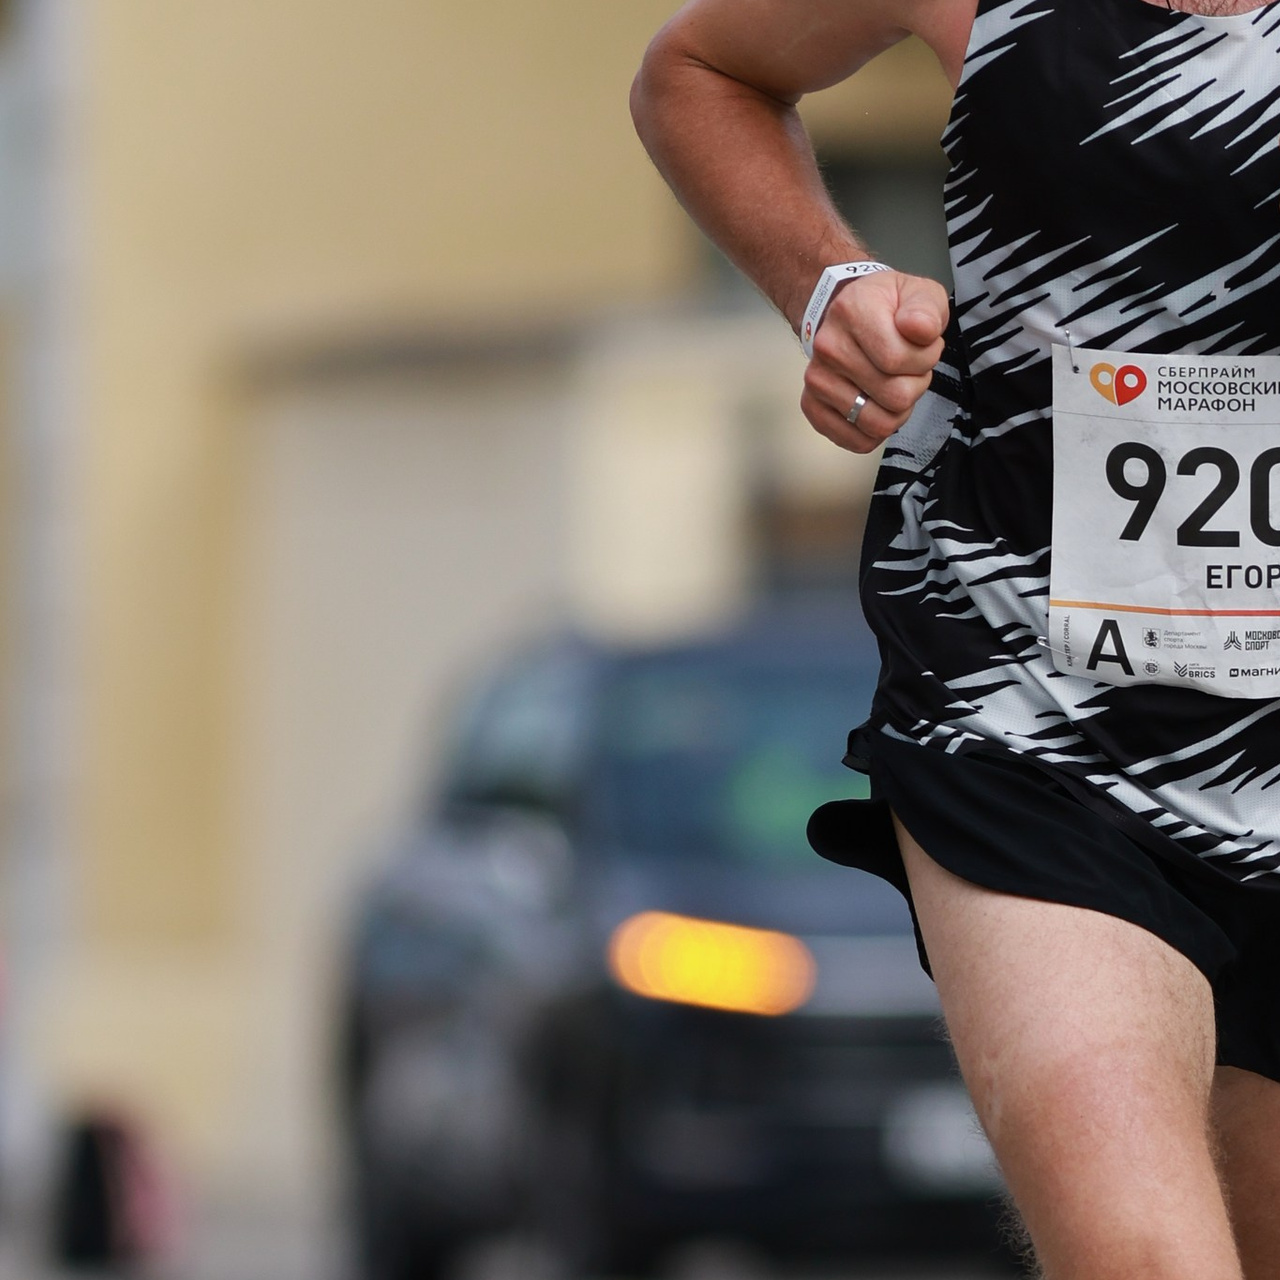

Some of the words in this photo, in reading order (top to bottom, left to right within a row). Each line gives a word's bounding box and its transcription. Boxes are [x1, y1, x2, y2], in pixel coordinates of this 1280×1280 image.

[1157, 365, 1256, 379] СБЕРПРАЙМ
[1157, 397, 1256, 412] МАРАФОН
[1244, 640, 1270, 651] СПОРТ
[1188, 670, 1216, 679] BRICS
